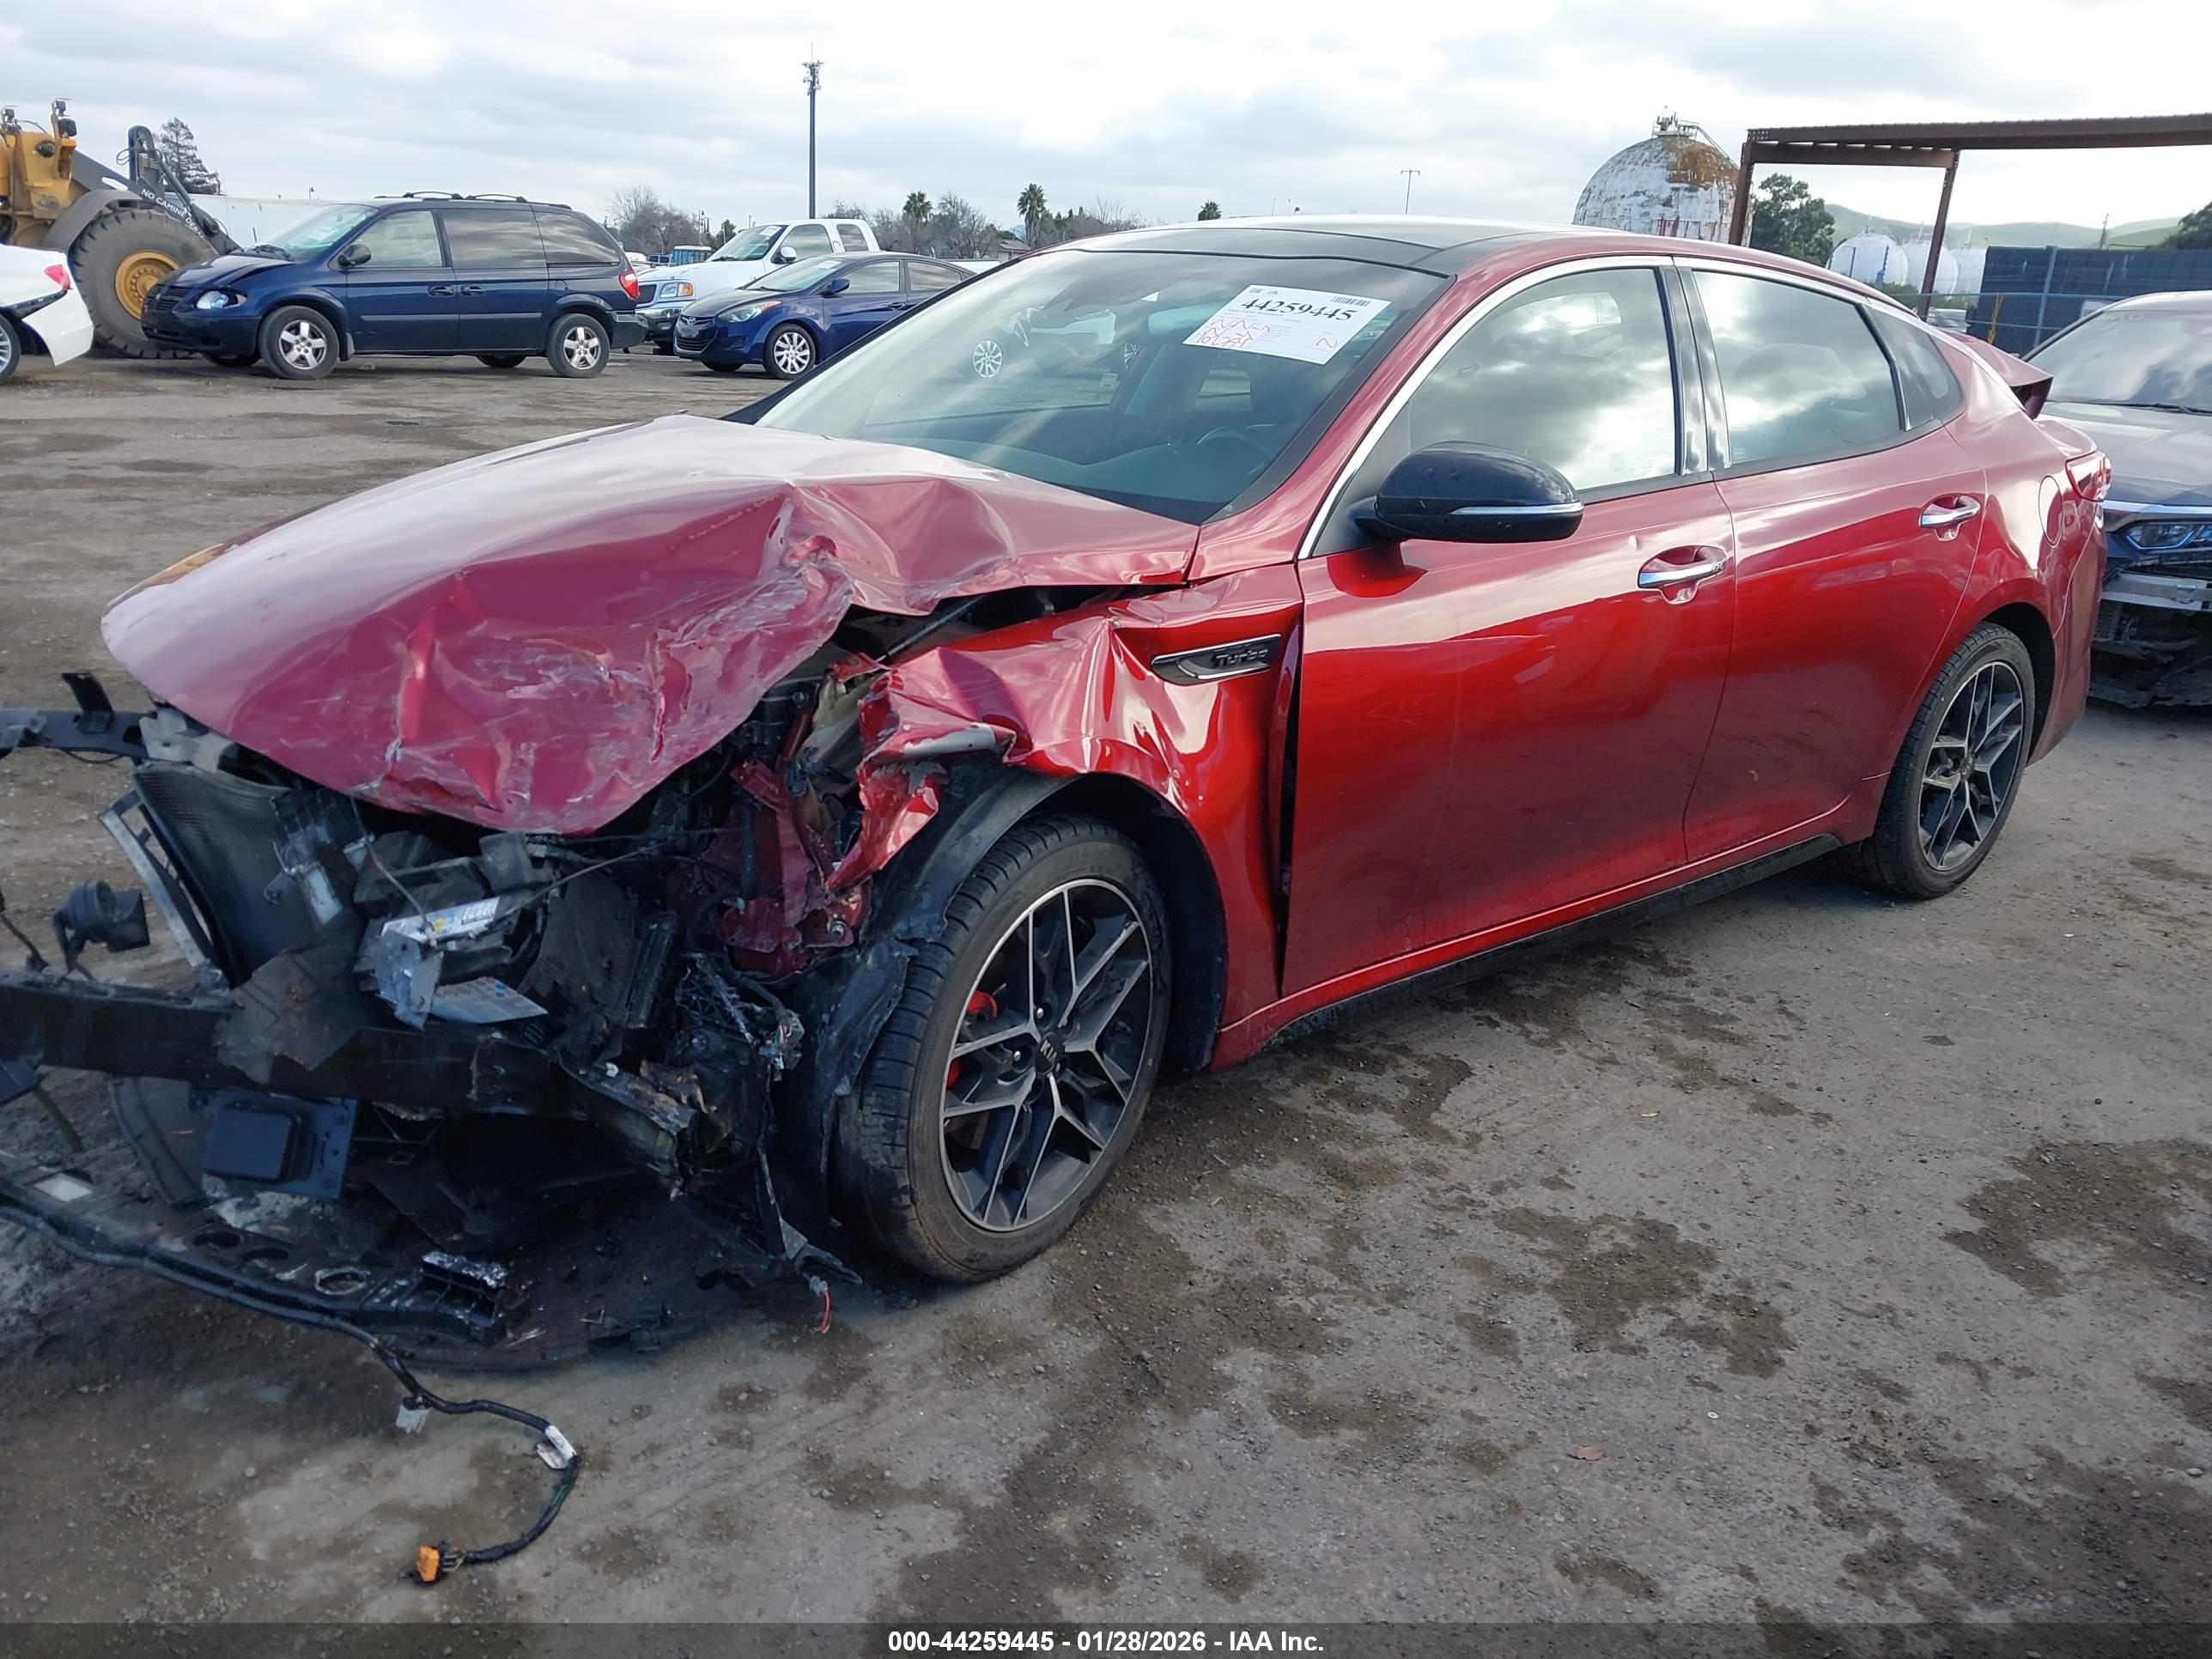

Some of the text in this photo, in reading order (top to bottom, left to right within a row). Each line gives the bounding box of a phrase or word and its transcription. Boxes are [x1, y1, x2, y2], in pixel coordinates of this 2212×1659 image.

[141, 188, 155, 199] NO
[155, 197, 186, 218] CAMINE
[1241, 298, 1358, 321] 44259445
[1215, 648, 1269, 667] Turbo
[1040, 1039, 1057, 1066] KIA
